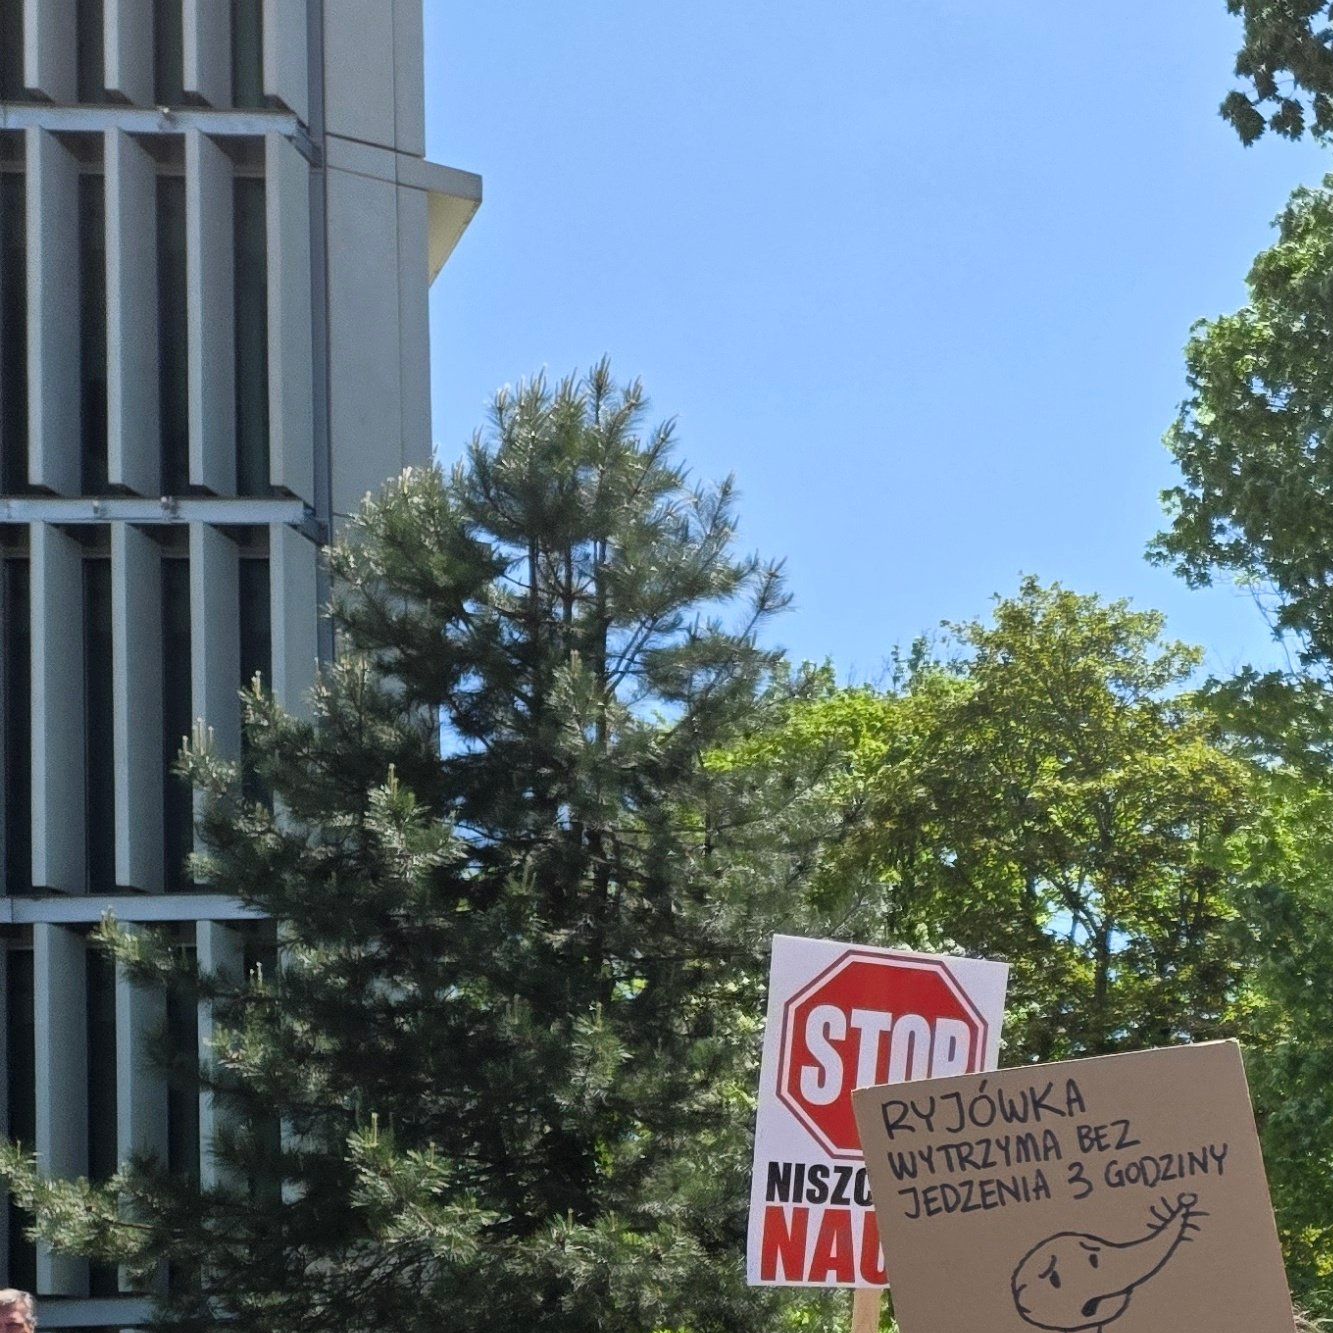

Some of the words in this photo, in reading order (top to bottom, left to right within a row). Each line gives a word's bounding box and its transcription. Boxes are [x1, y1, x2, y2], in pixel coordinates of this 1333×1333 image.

[800, 1004, 971, 1106] STOP
[881, 1079, 1086, 1139] RYJÓWKA
[765, 1162, 874, 1207] NISZC
[888, 1129, 1063, 1181] WYTRZYMA
[1076, 1119, 1141, 1153] BEZ
[898, 1169, 1051, 1219] JEDZENIA
[1068, 1162, 1094, 1199] 3
[1105, 1143, 1228, 1188] GODZINY
[761, 1206, 888, 1285] NAU
